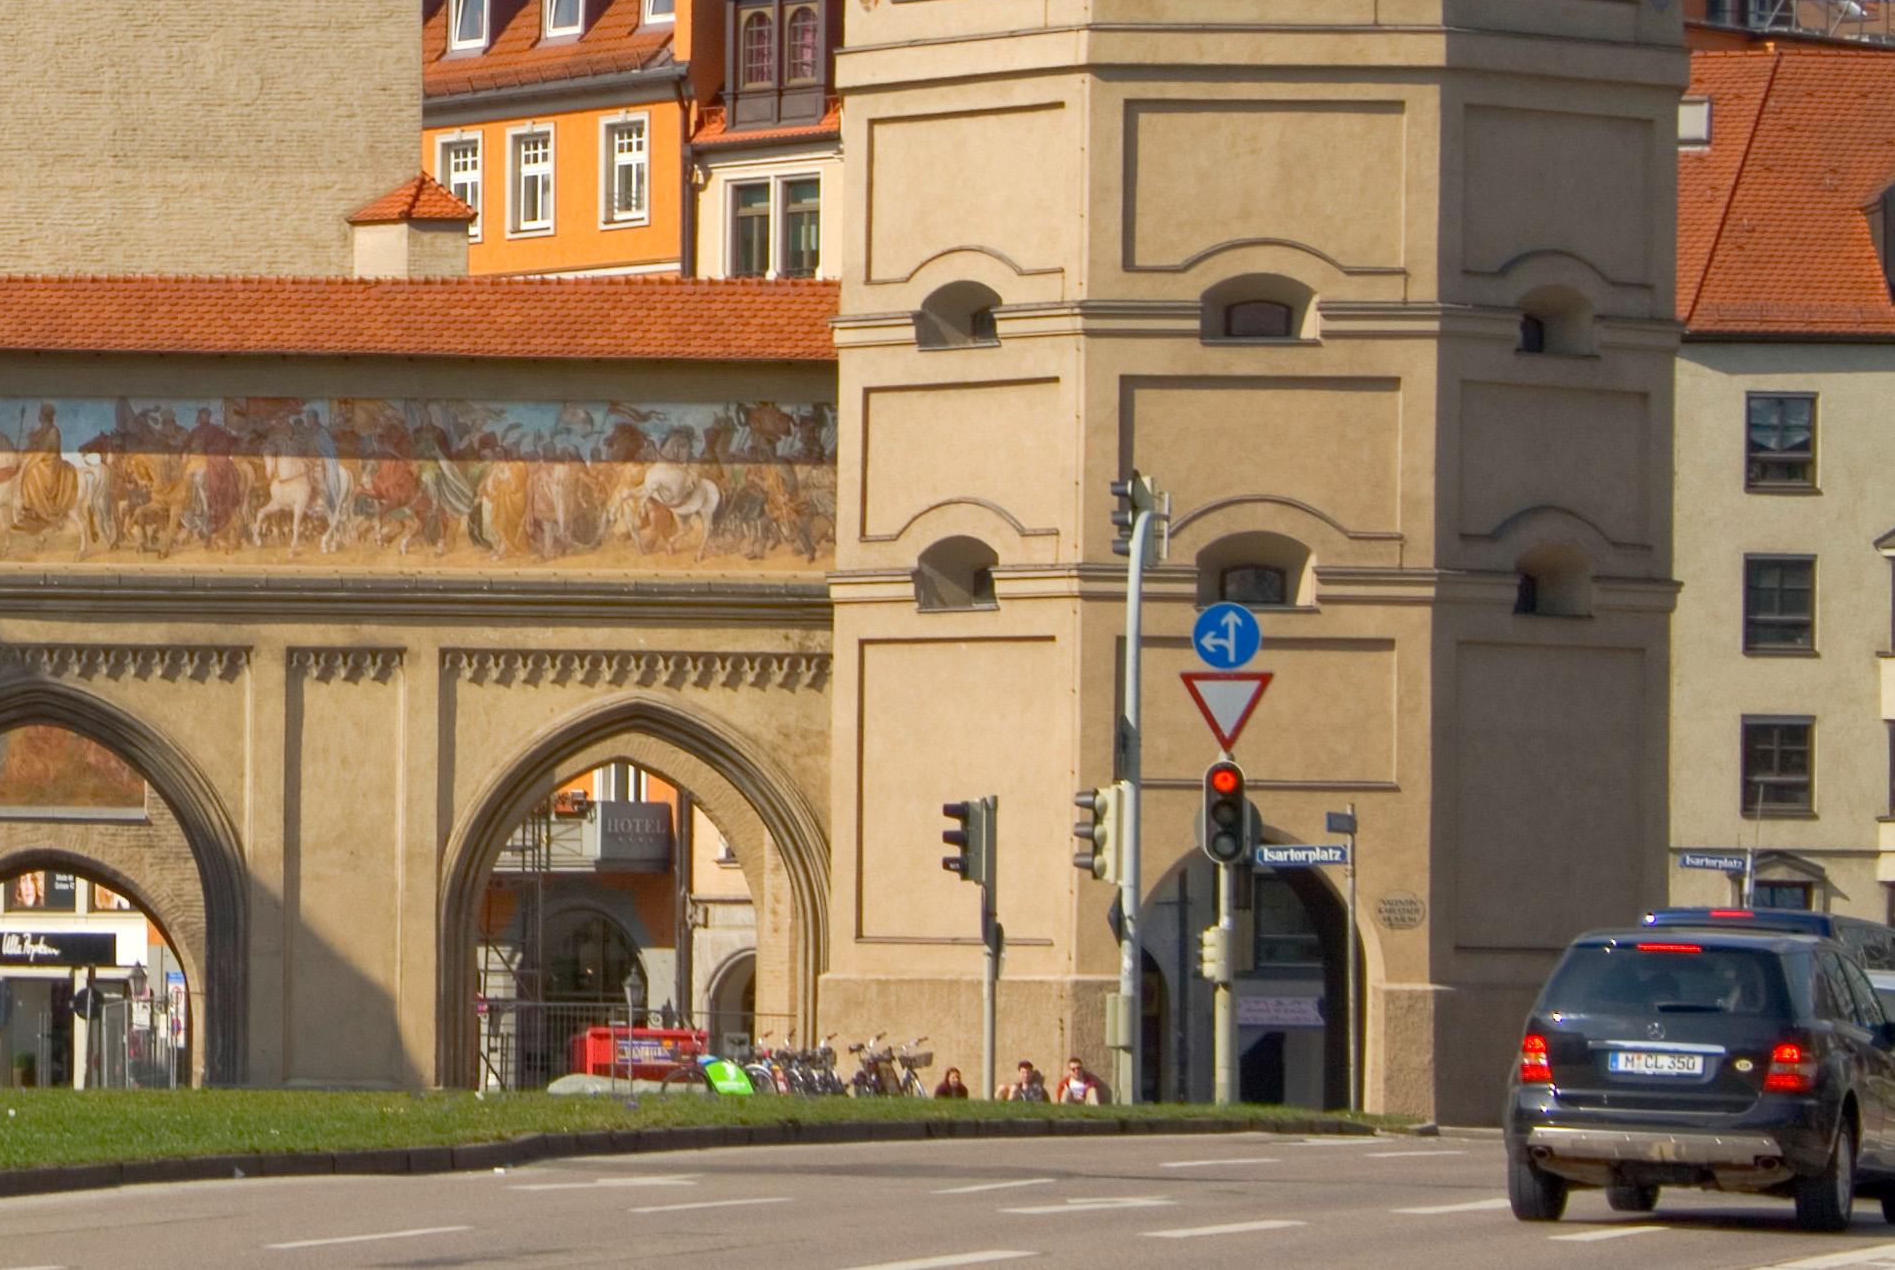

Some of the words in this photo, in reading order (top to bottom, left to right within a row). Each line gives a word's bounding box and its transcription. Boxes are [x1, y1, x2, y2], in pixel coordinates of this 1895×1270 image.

[607, 817, 666, 834] HOTEL
[1263, 847, 1342, 864] Isartorplatz
[1686, 854, 1743, 869] Isartorplatz
[1624, 1054, 1635, 1068] M
[1644, 1054, 1663, 1070] CL
[1667, 1055, 1696, 1071] 350
